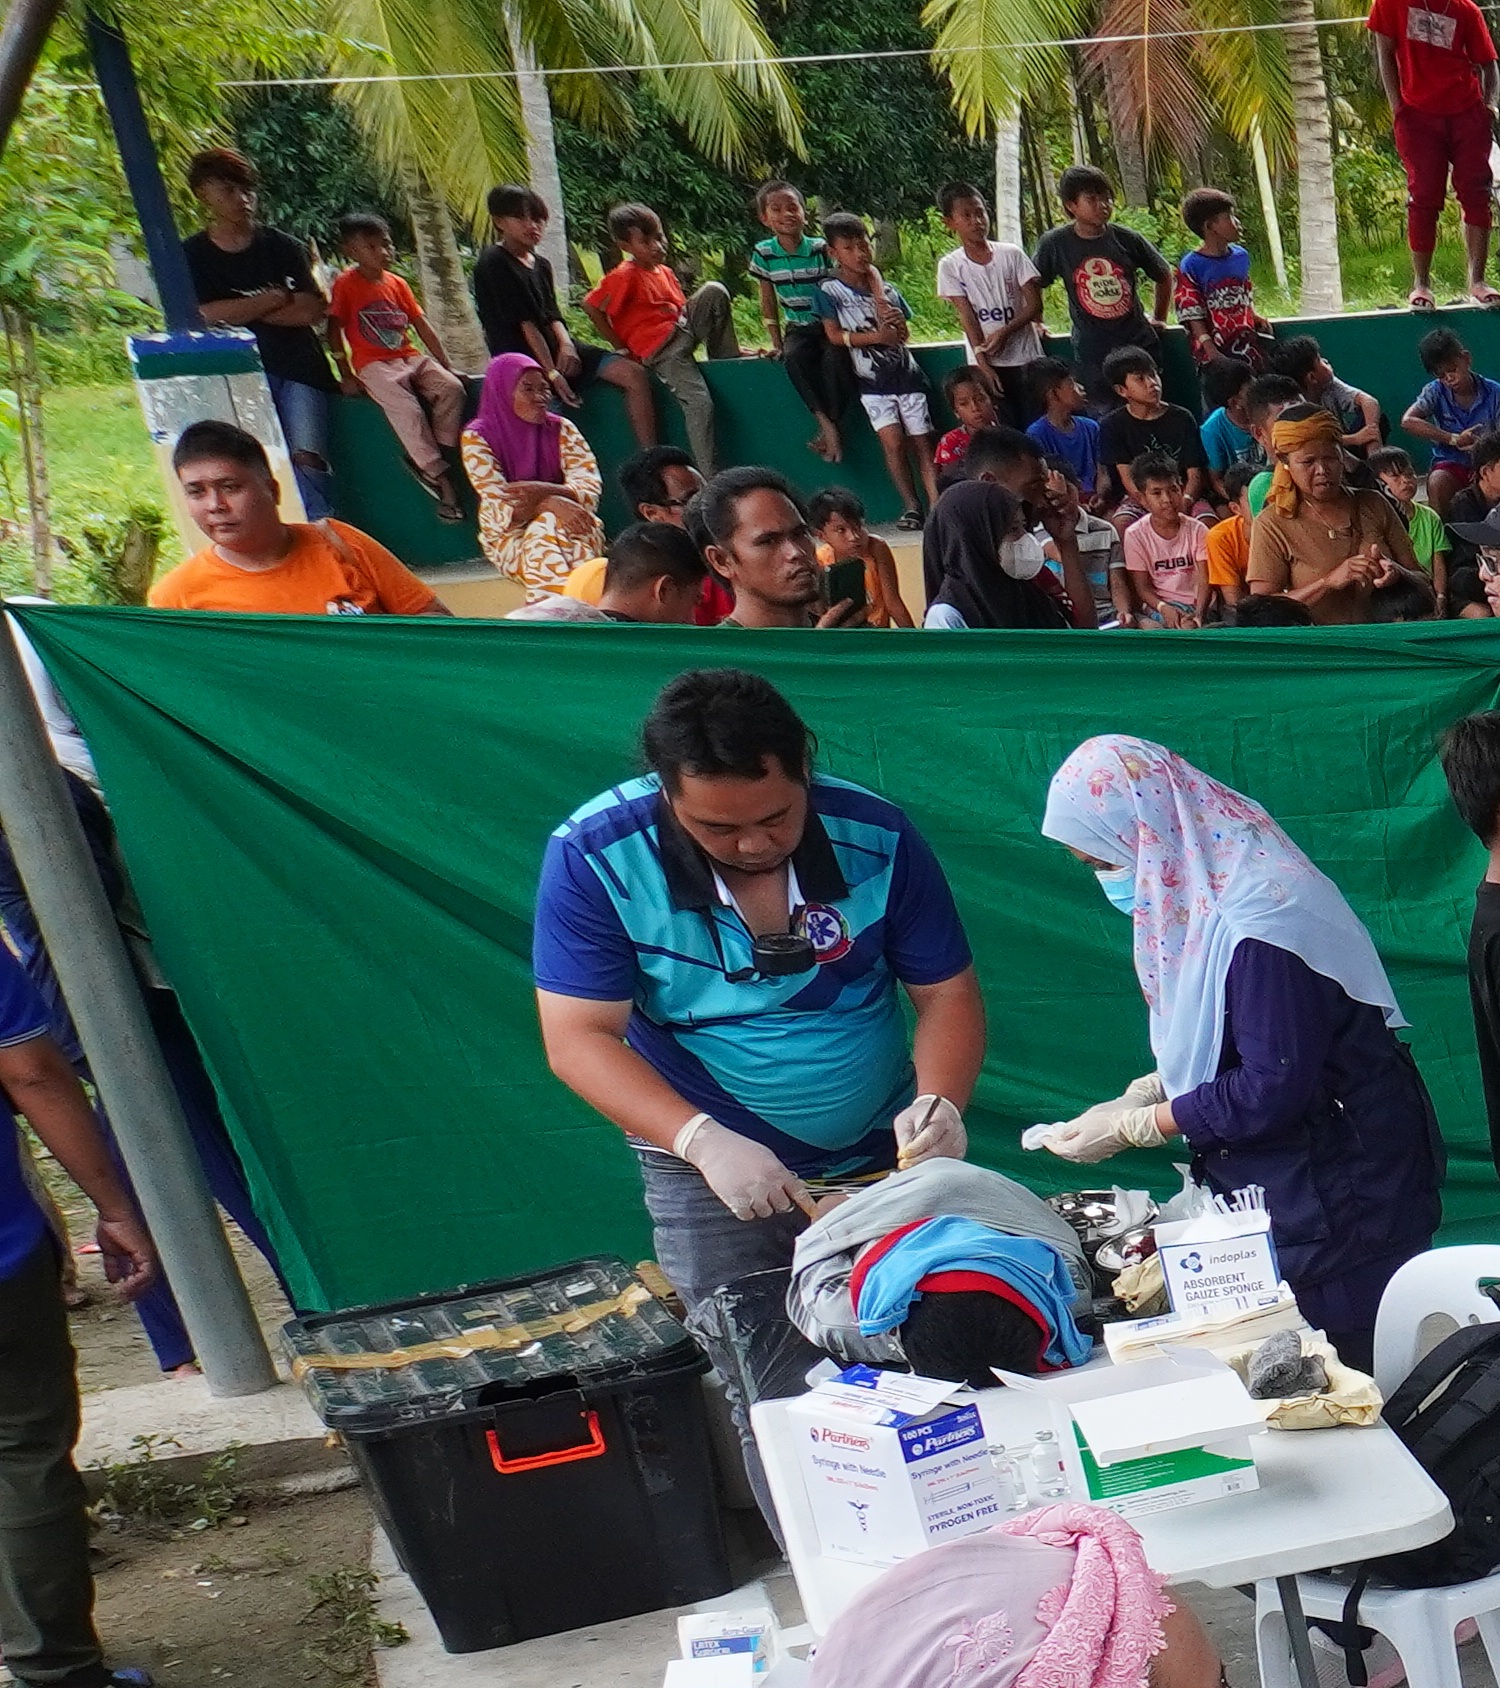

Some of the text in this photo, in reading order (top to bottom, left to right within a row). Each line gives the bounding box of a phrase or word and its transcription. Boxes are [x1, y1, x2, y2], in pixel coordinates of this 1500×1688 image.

[978, 306, 1015, 325] eep
[1209, 1249, 1258, 1265] indoplas
[1183, 1271, 1246, 1290] ABSORBENT
[1185, 1280, 1266, 1302] GAUZE SPONGE
[821, 1427, 871, 1451] Partners
[924, 1425, 976, 1451] Partners
[910, 1463, 943, 1480] Syringe
[961, 1449, 990, 1463] Needle
[929, 1502, 1000, 1533] PYROGEN FREE
